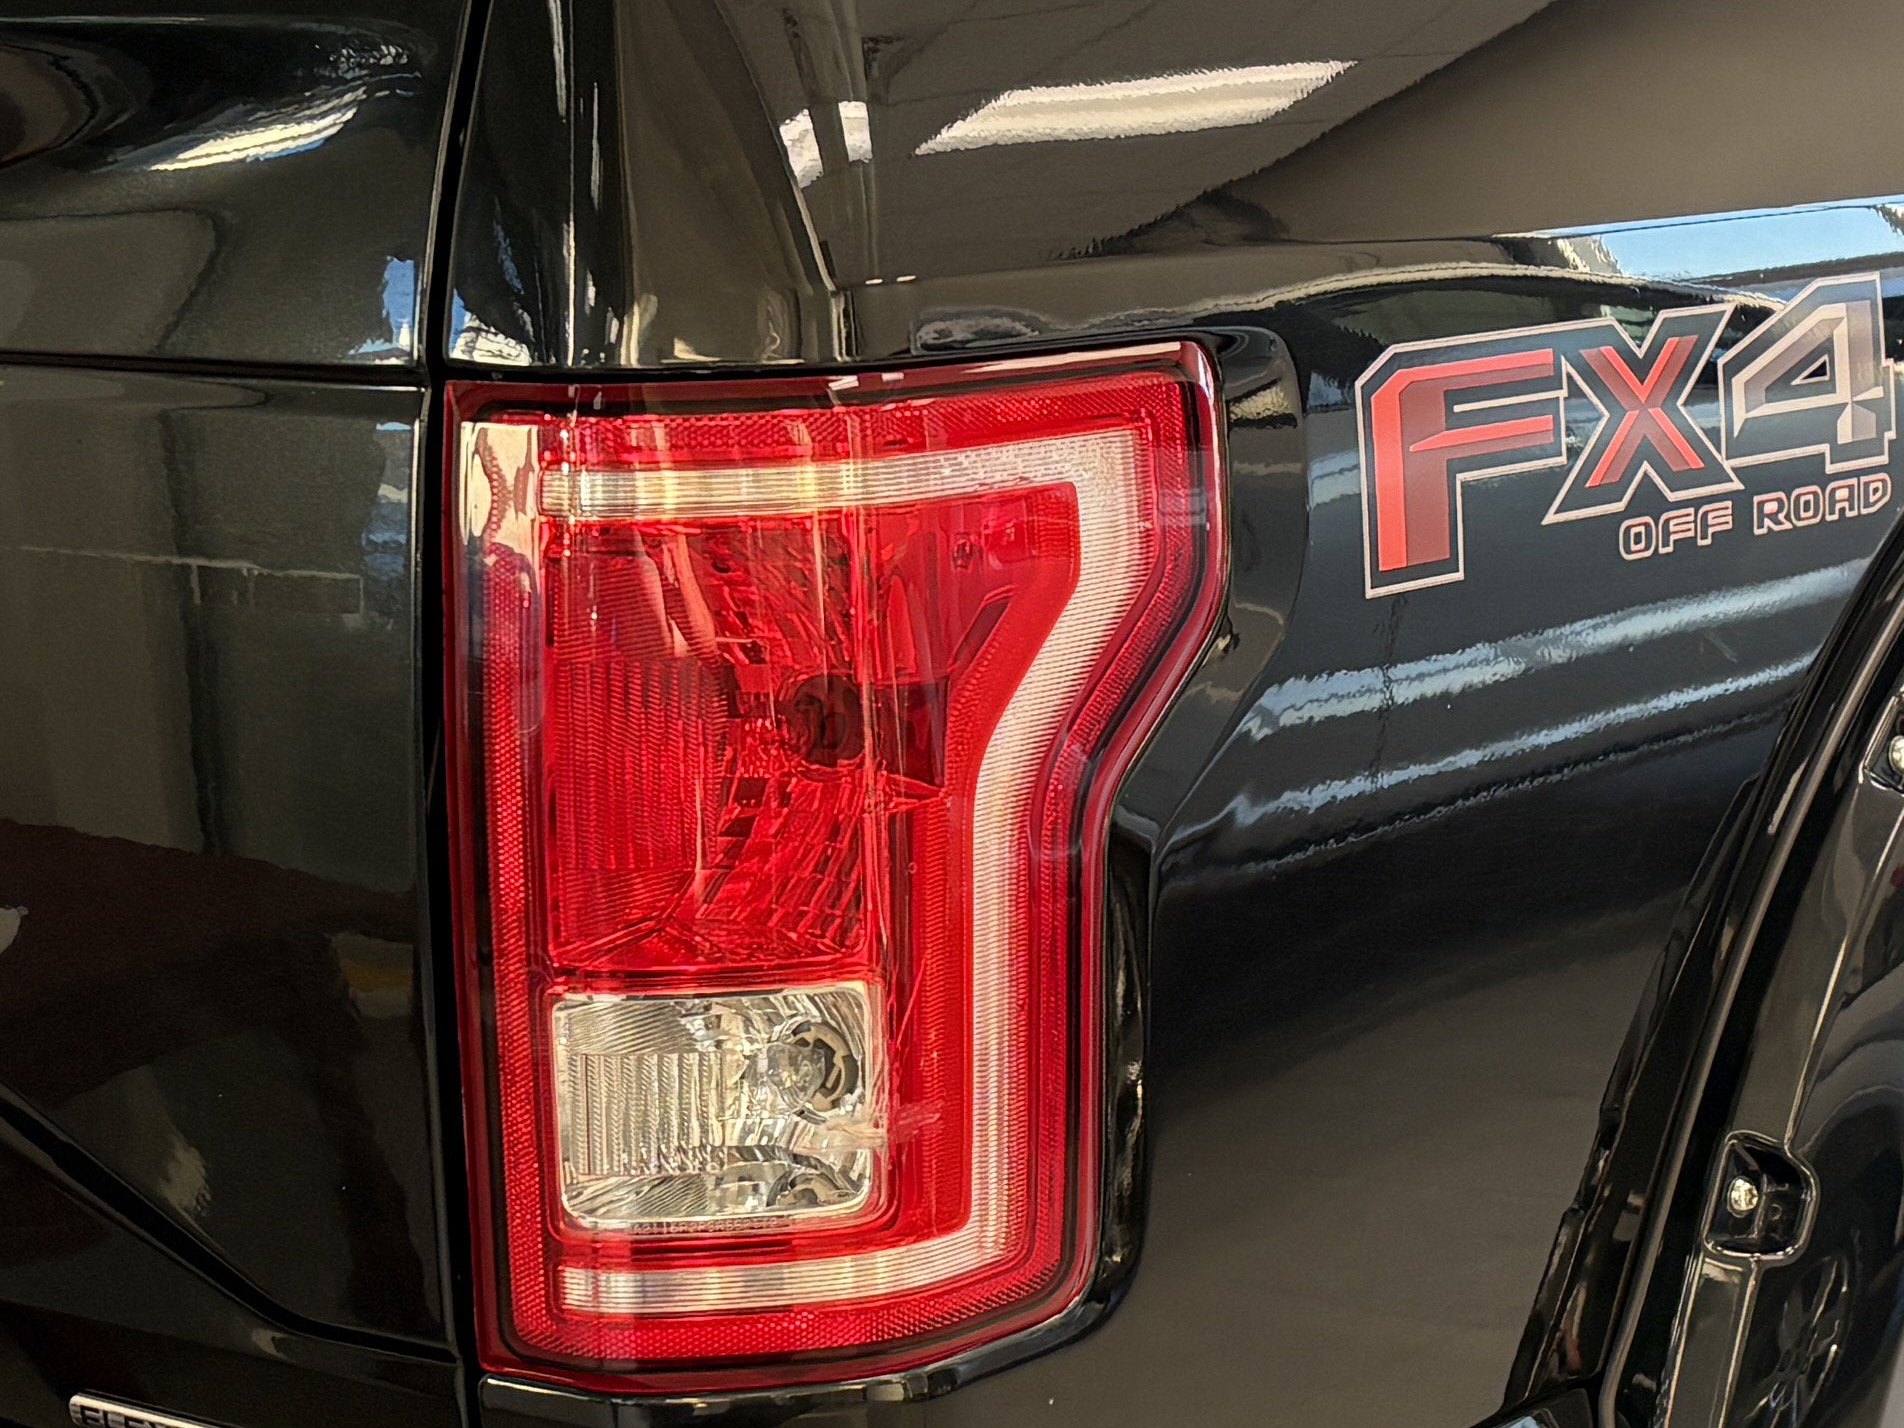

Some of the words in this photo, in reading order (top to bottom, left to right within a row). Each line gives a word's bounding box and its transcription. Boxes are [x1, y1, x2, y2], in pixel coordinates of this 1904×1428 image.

[1355, 271, 1895, 599] FX4
[1619, 500, 1733, 562] OFF
[1752, 472, 1893, 537] ROAD
